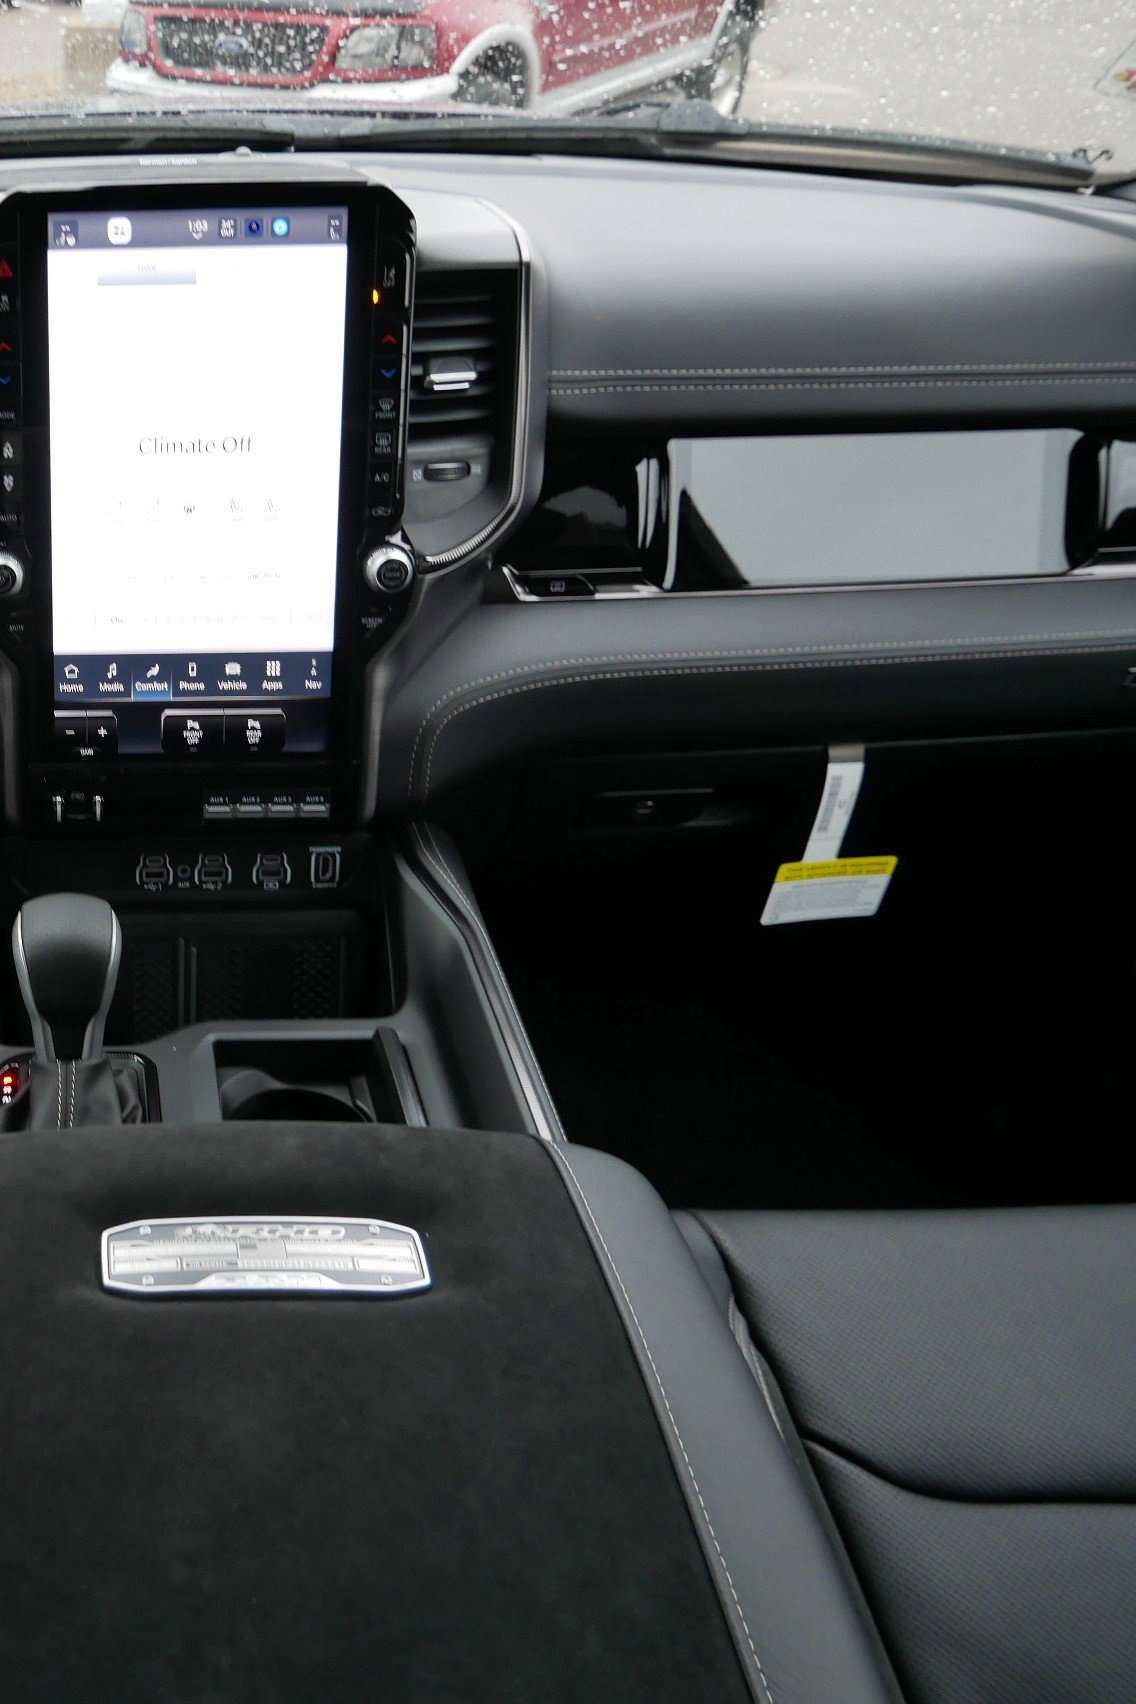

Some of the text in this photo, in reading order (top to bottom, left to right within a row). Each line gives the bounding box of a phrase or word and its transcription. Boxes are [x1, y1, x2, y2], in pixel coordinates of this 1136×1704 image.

[139, 435, 253, 455] Climate Off
[374, 472, 390, 483] A/C
[59, 682, 84, 693] Home
[99, 681, 124, 692] Media
[135, 681, 168, 692] Comfort
[179, 680, 205, 691] Phone
[217, 680, 247, 691] Vehicle
[262, 681, 283, 692] Apps
[305, 679, 322, 690] Nav
[183, 730, 203, 738] FRONT
[187, 737, 200, 745] OFF
[306, 795, 318, 803] AUX
